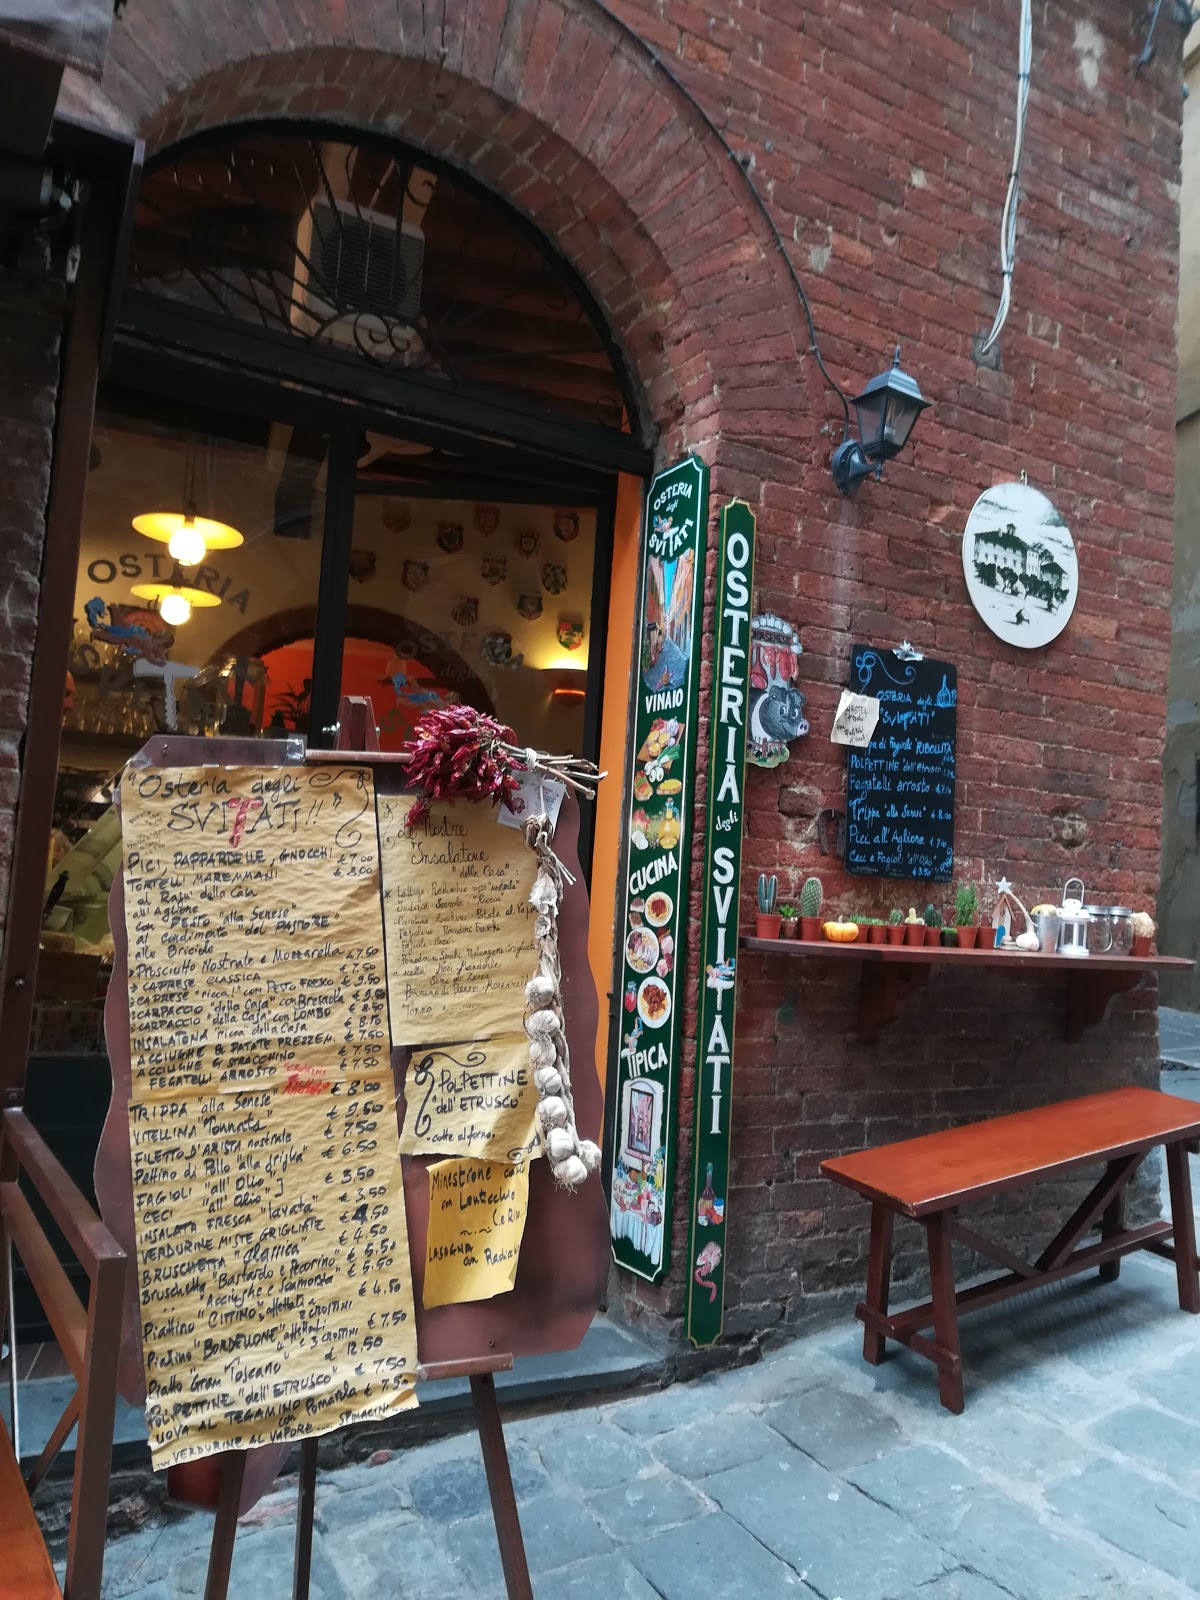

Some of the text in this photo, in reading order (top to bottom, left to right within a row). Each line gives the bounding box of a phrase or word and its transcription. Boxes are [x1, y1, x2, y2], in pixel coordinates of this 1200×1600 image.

[653, 481, 693, 511] OSTERIA
[649, 517, 695, 557] SVITATI
[716, 532, 750, 803] OSTERIA
[645, 688, 683, 714] VINAIO
[875, 690, 912, 704] OSTERIA
[251, 773, 301, 802] degli
[897, 778, 930, 793] arrosto
[715, 809, 739, 832] degli
[849, 824, 870, 845] Pici
[279, 847, 332, 862] GNOCCHI
[126, 876, 186, 892] TORTELLI
[629, 851, 679, 896] CUCINA
[200, 886, 225, 901] della
[230, 885, 258, 898] Casa
[170, 914, 210, 929] PESTO
[135, 946, 156, 960] alle
[136, 942, 344, 979] Prosciutto Nostrale Mozzarella
[137, 991, 189, 1005] CAPRESE
[266, 980, 297, 994] PESTO
[142, 979, 195, 993] CAPRESE
[206, 972, 261, 985] CLASSICA
[705, 847, 735, 1134] SVITATI
[137, 1005, 203, 1020] CARPACCIO
[138, 1018, 201, 1032] CARPACCIO
[293, 1008, 331, 1021] LOMBO
[133, 1029, 208, 1051] INSALATONA
[137, 1045, 207, 1066] ACCIUGHE
[230, 1038, 270, 1053] PATATE
[137, 1061, 203, 1078] ACCIUGHE
[227, 1051, 295, 1068] STRACCHINO
[620, 1042, 668, 1079] TIPICA
[149, 1073, 212, 1090] FEGATELLI
[220, 1066, 277, 1082] ARROSTO
[438, 1068, 528, 1093] POLPETTINE
[129, 1102, 188, 1123] TRIPPA
[133, 1124, 196, 1145] VITELLINA
[134, 1147, 184, 1167] FILETTO
[184, 1163, 197, 1179] di
[204, 1158, 230, 1176] Pollo
[431, 1165, 492, 1200] Minestrone
[136, 1187, 192, 1208] FAGIOLI
[441, 1199, 453, 1211] con
[140, 1221, 197, 1244] INSALATA
[206, 1214, 252, 1230] FRESCA
[143, 1210, 173, 1224] CECI
[141, 1238, 214, 1265] VERDURINE
[218, 1232, 254, 1249] MISTE
[260, 1216, 325, 1240] GRIGLIATE
[429, 1242, 479, 1268] LASAGNA con
[141, 1257, 226, 1288] BRUSCHETTA
[141, 1277, 206, 1305] Bruschetta
[309, 1300, 352, 1320] CROSTINI
[143, 1317, 195, 1343] Piattino
[322, 1327, 358, 1342] CROSTINI
[148, 1374, 183, 1398] Piatto
[155, 1400, 301, 1444] UOVA AL TEGAMINO
[279, 1414, 296, 1427] con
[173, 1436, 244, 1463] VERDURINE
[248, 1435, 265, 1445] AL
[269, 1423, 314, 1442] VAPORE
